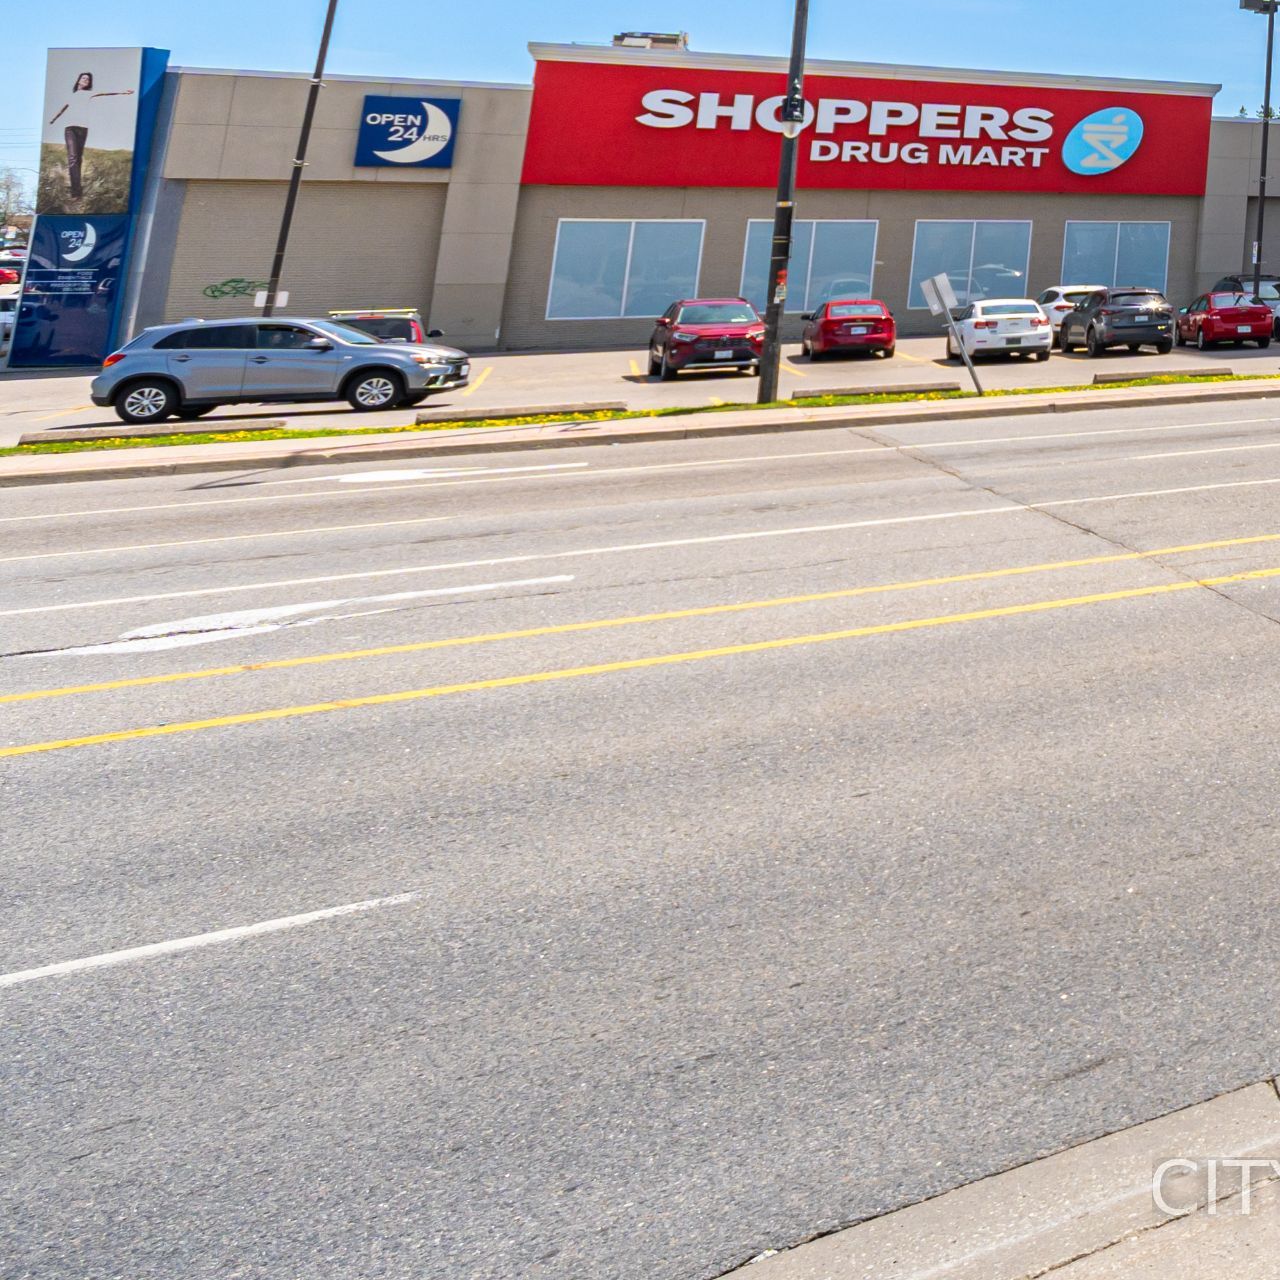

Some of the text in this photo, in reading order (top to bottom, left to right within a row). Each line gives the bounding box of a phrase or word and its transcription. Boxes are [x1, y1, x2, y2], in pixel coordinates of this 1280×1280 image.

[366, 113, 422, 126] OPEN
[635, 89, 1055, 142] SHOPPERS
[387, 126, 448, 142] 24 HRS
[809, 140, 1049, 168] DRUG MART
[61, 230, 85, 239] OPEN
[68, 238, 82, 248] 24
